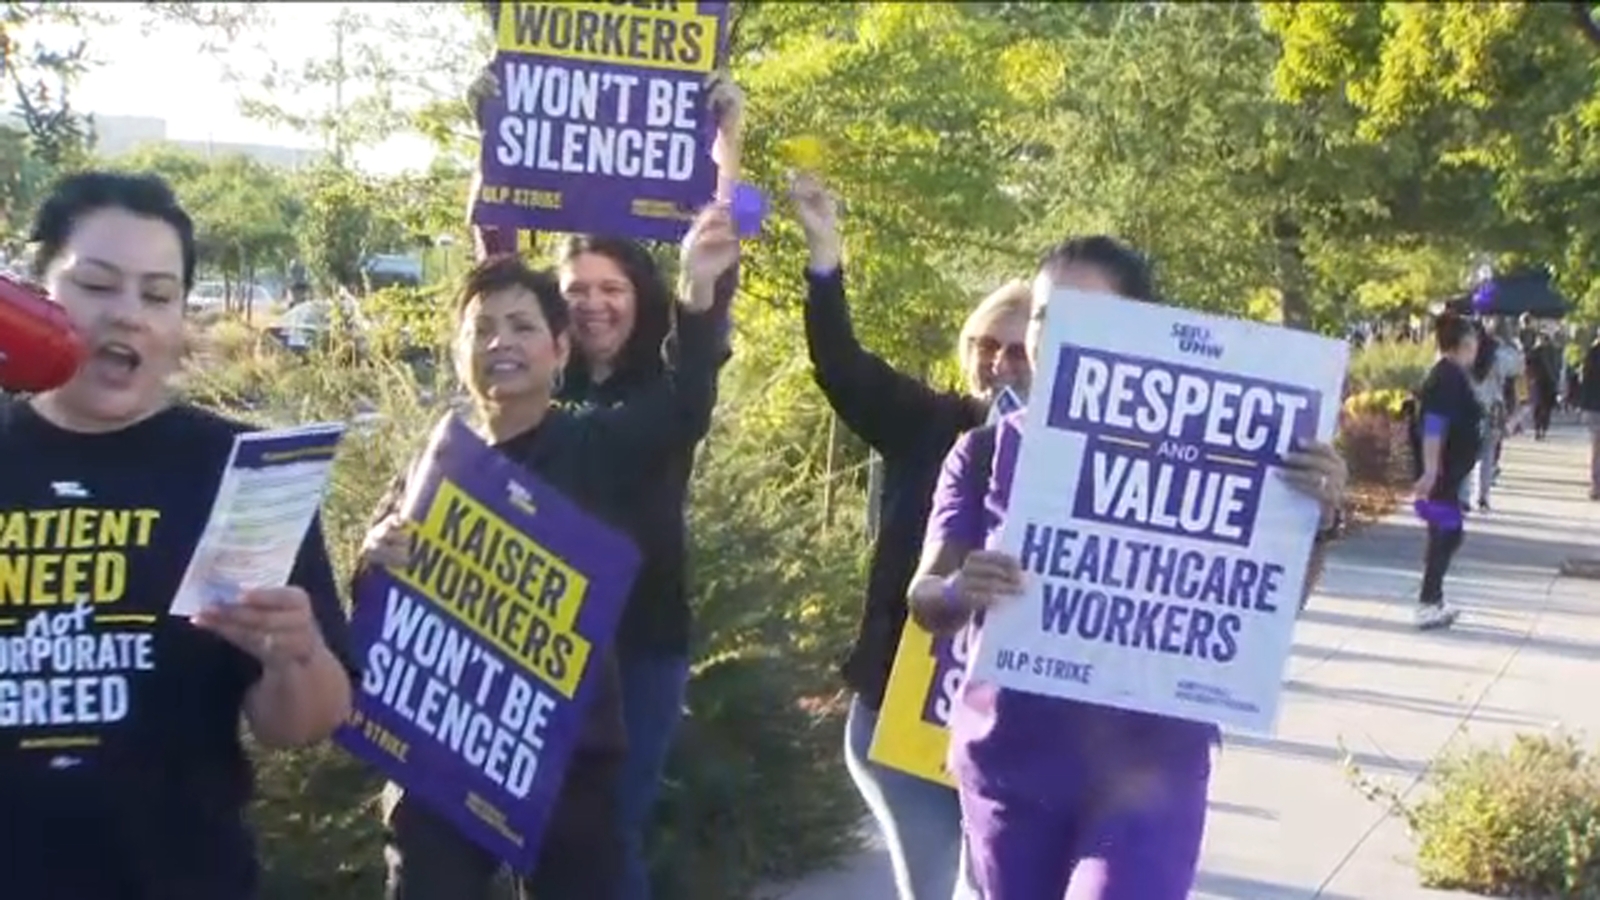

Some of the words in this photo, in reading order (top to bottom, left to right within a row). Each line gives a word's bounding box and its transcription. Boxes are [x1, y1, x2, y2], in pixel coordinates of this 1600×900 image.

[513, 4, 704, 64] WORKERS
[505, 62, 639, 124] WON'T
[646, 78, 699, 128] BE
[497, 117, 697, 180] SILENCED
[1068, 356, 1308, 455] RESPECT
[1156, 441, 1199, 462] AND
[0, 509, 161, 550] ATIENT
[1092, 452, 1252, 538] VALUE
[0, 552, 127, 606] NEED
[438, 496, 568, 617] KAISER
[1021, 523, 1286, 613] HEALTHCARE
[404, 528, 574, 681] WORKERS
[1041, 584, 1242, 664] WORKERS
[0, 676, 130, 726] GREED
[381, 587, 505, 708] WON'T
[500, 673, 557, 750] BE
[996, 649, 1029, 673] ULP
[1032, 656, 1094, 685] STRIKE
[362, 643, 540, 800] SILENCED
